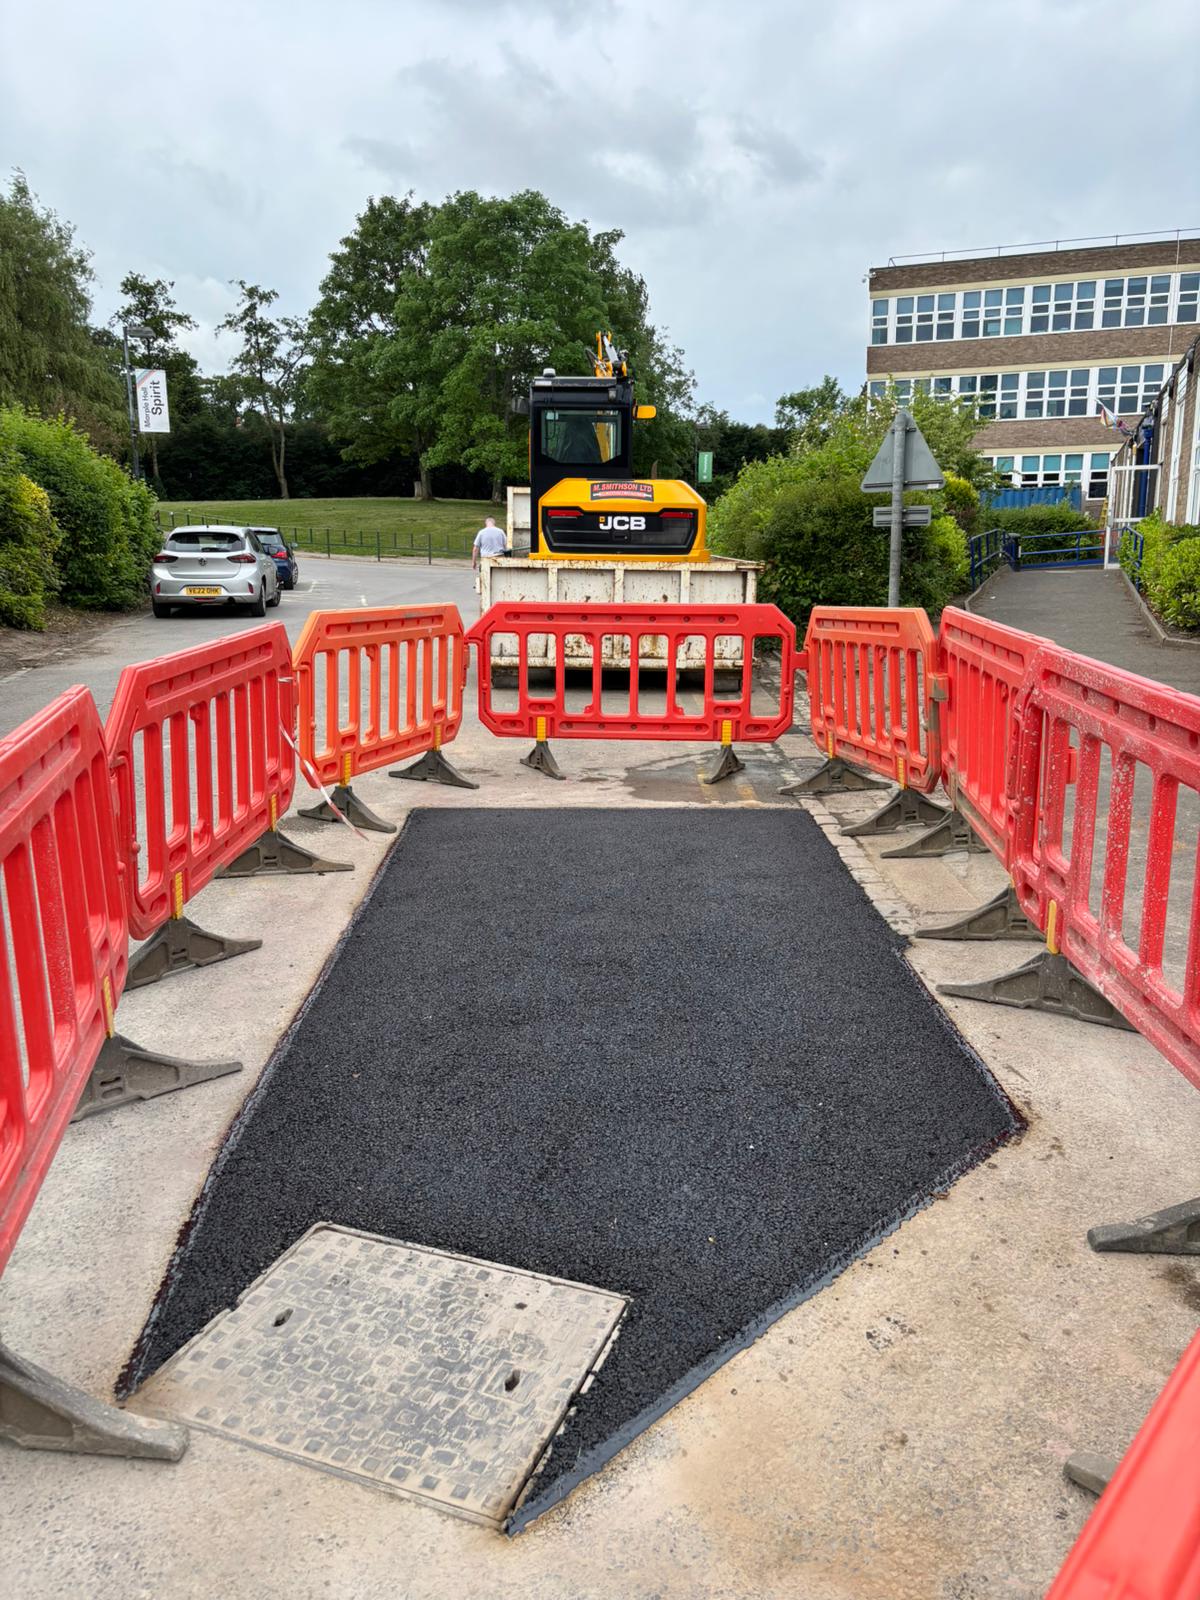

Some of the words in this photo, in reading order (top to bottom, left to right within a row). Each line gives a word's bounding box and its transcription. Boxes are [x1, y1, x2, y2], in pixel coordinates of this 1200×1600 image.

[141, 386, 149, 401] Hall
[149, 380, 164, 415] Spirit
[143, 402, 151, 428] Marple
[601, 483, 638, 491] SMITHSON
[639, 484, 652, 492] LTD
[599, 515, 646, 530] JCB
